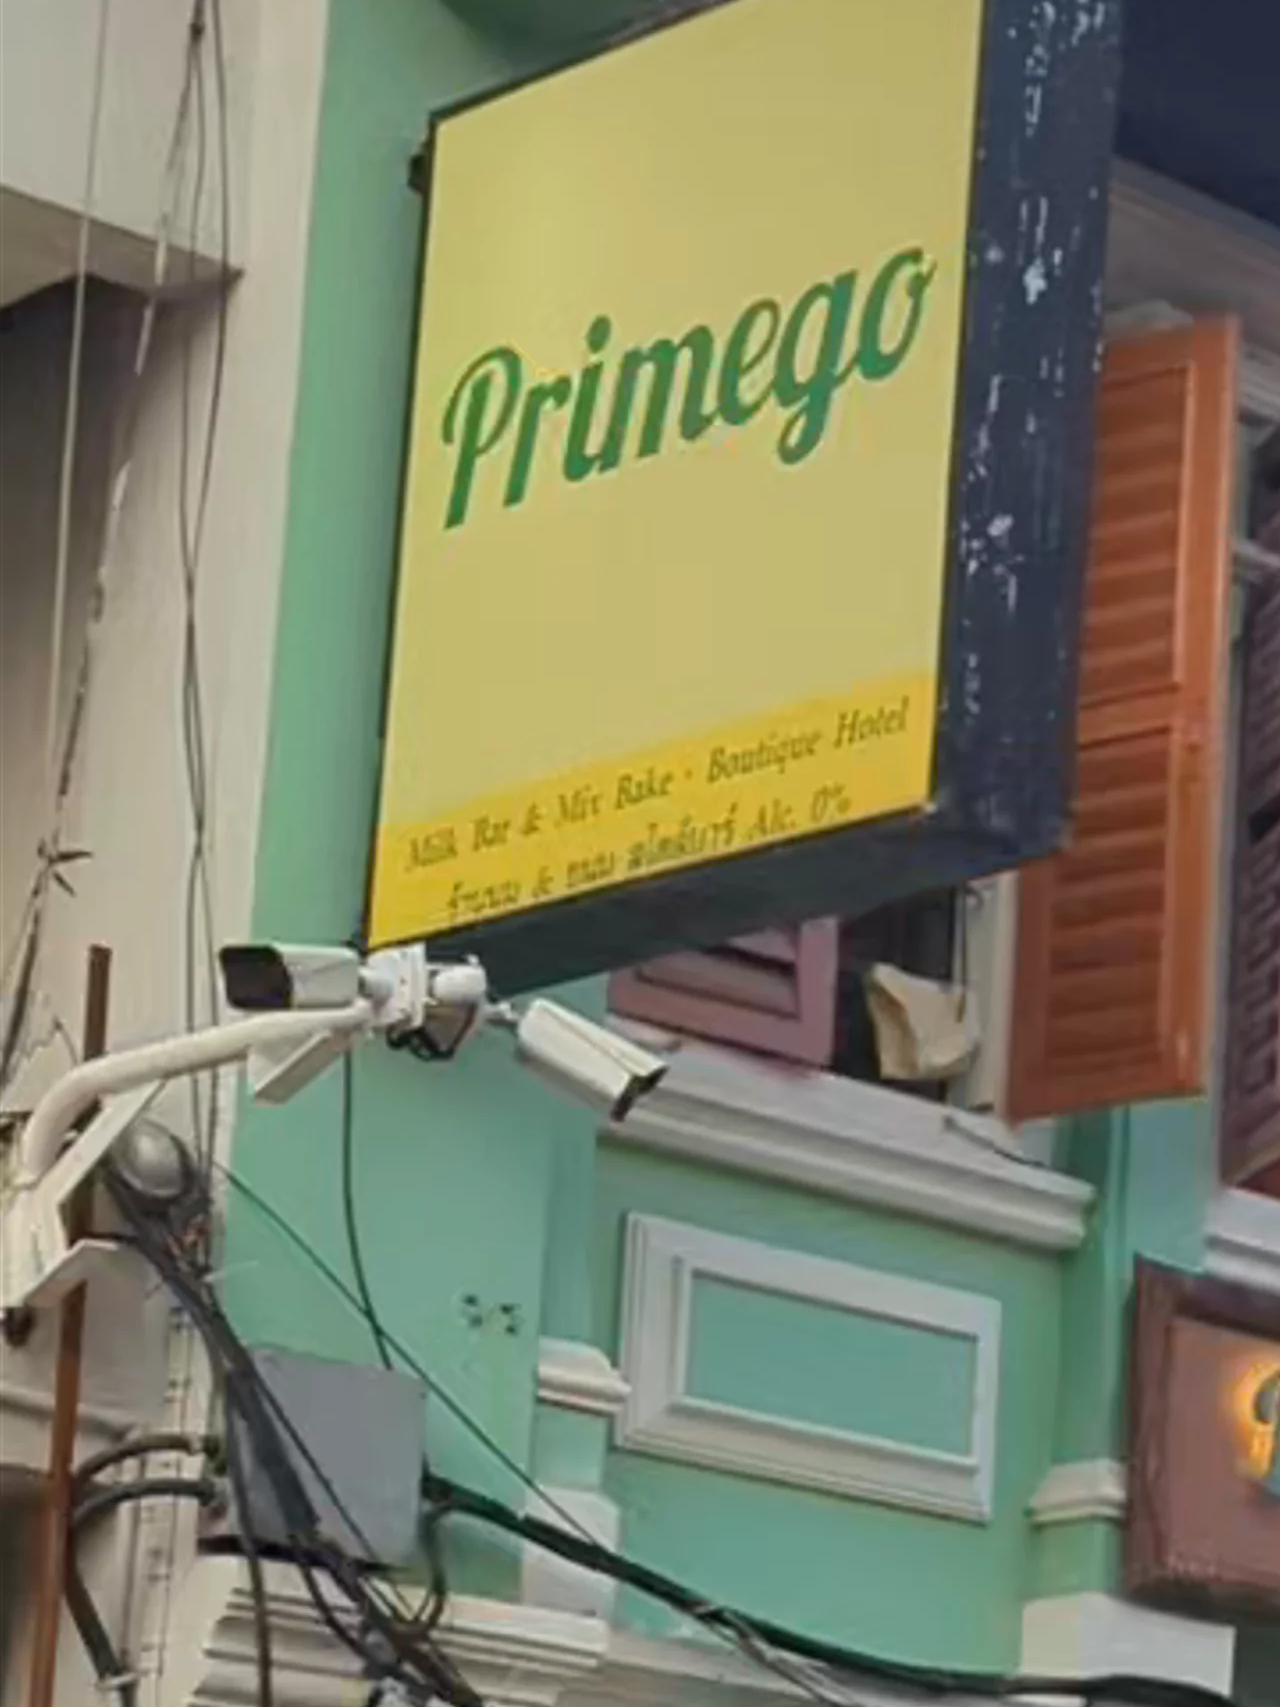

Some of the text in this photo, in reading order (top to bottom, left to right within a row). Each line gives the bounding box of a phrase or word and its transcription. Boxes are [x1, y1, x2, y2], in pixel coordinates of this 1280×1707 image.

[442, 246, 937, 530] Primego
[706, 729, 822, 784] Boutique
[832, 694, 910, 749] Hotel
